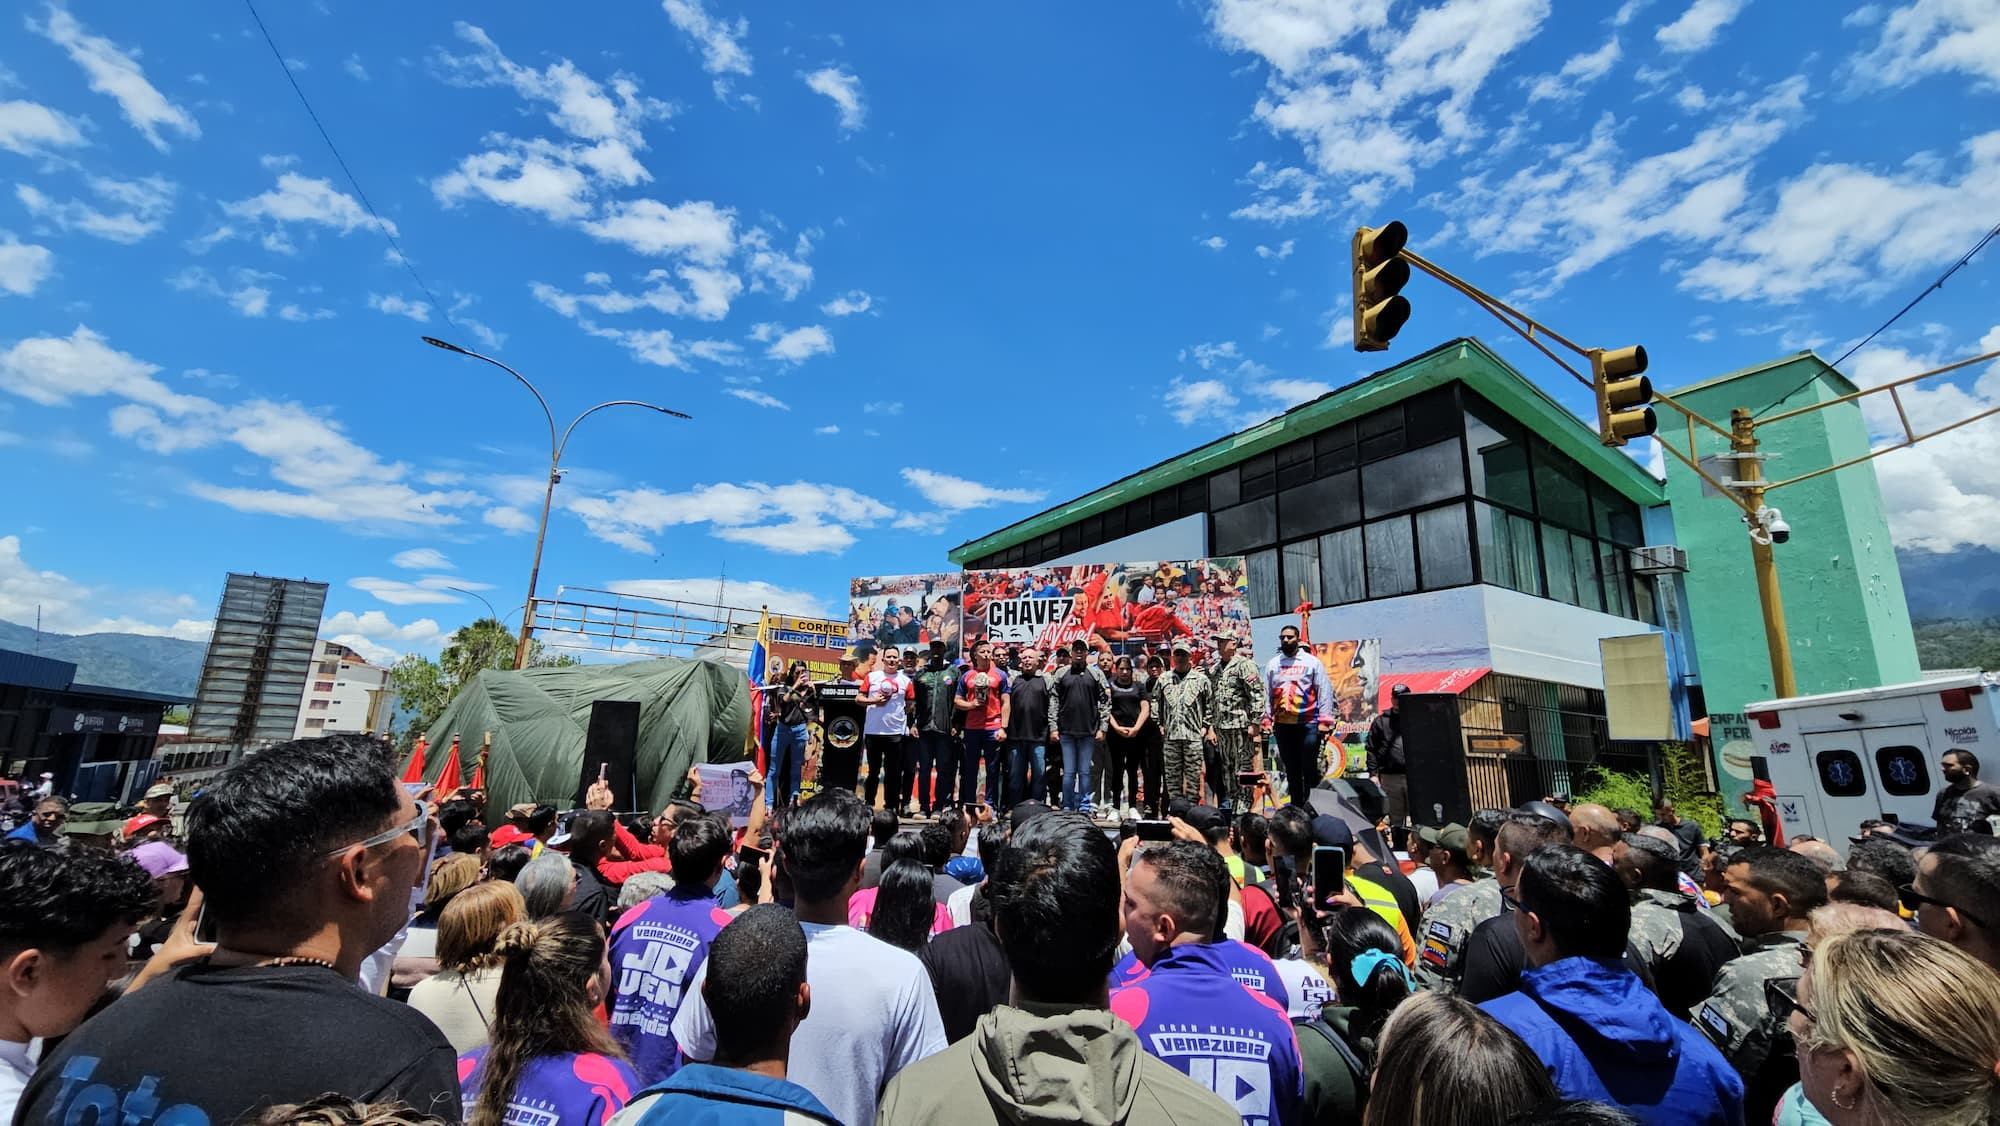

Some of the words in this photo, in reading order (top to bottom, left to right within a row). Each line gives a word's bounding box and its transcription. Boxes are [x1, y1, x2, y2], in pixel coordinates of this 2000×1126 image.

[989, 592, 1074, 626] CHÁVEZ
[1724, 727, 1752, 739] PER
[1301, 976, 1330, 988] Ae
[1159, 1024, 1198, 1033] GRAN
[1210, 1025, 1264, 1039] MISIÓN
